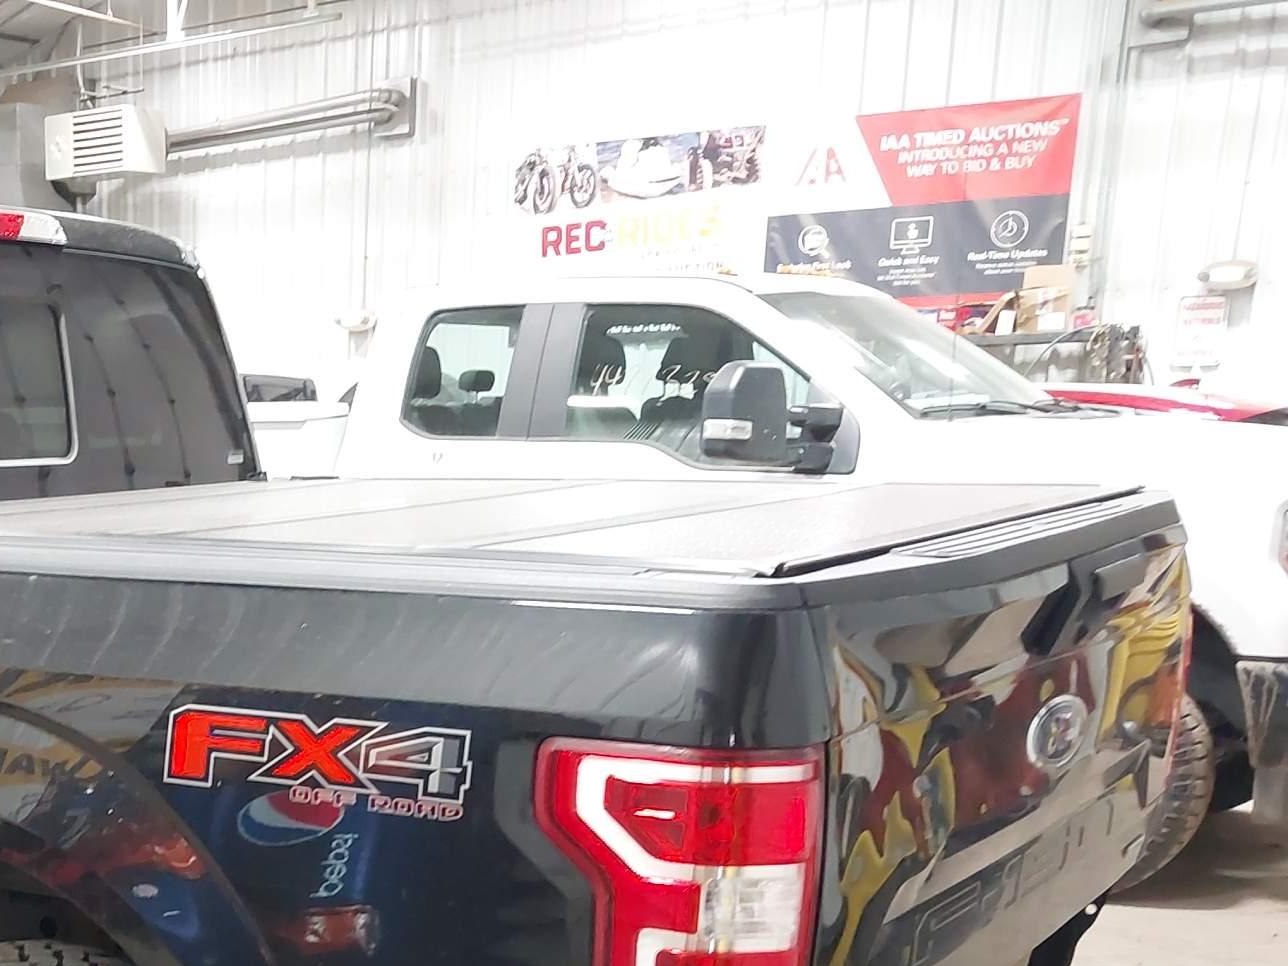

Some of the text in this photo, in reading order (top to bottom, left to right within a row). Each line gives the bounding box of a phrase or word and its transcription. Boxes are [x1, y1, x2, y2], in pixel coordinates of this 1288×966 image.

[880, 134, 911, 152] IAA
[914, 129, 966, 148] TIMED
[898, 139, 1048, 164] INTRODUCING A NEW
[906, 155, 1037, 178] WAY TO BID & BUY
[541, 220, 608, 257] REC
[163, 704, 472, 804] FX4
[289, 785, 463, 823] OFF ROAD
